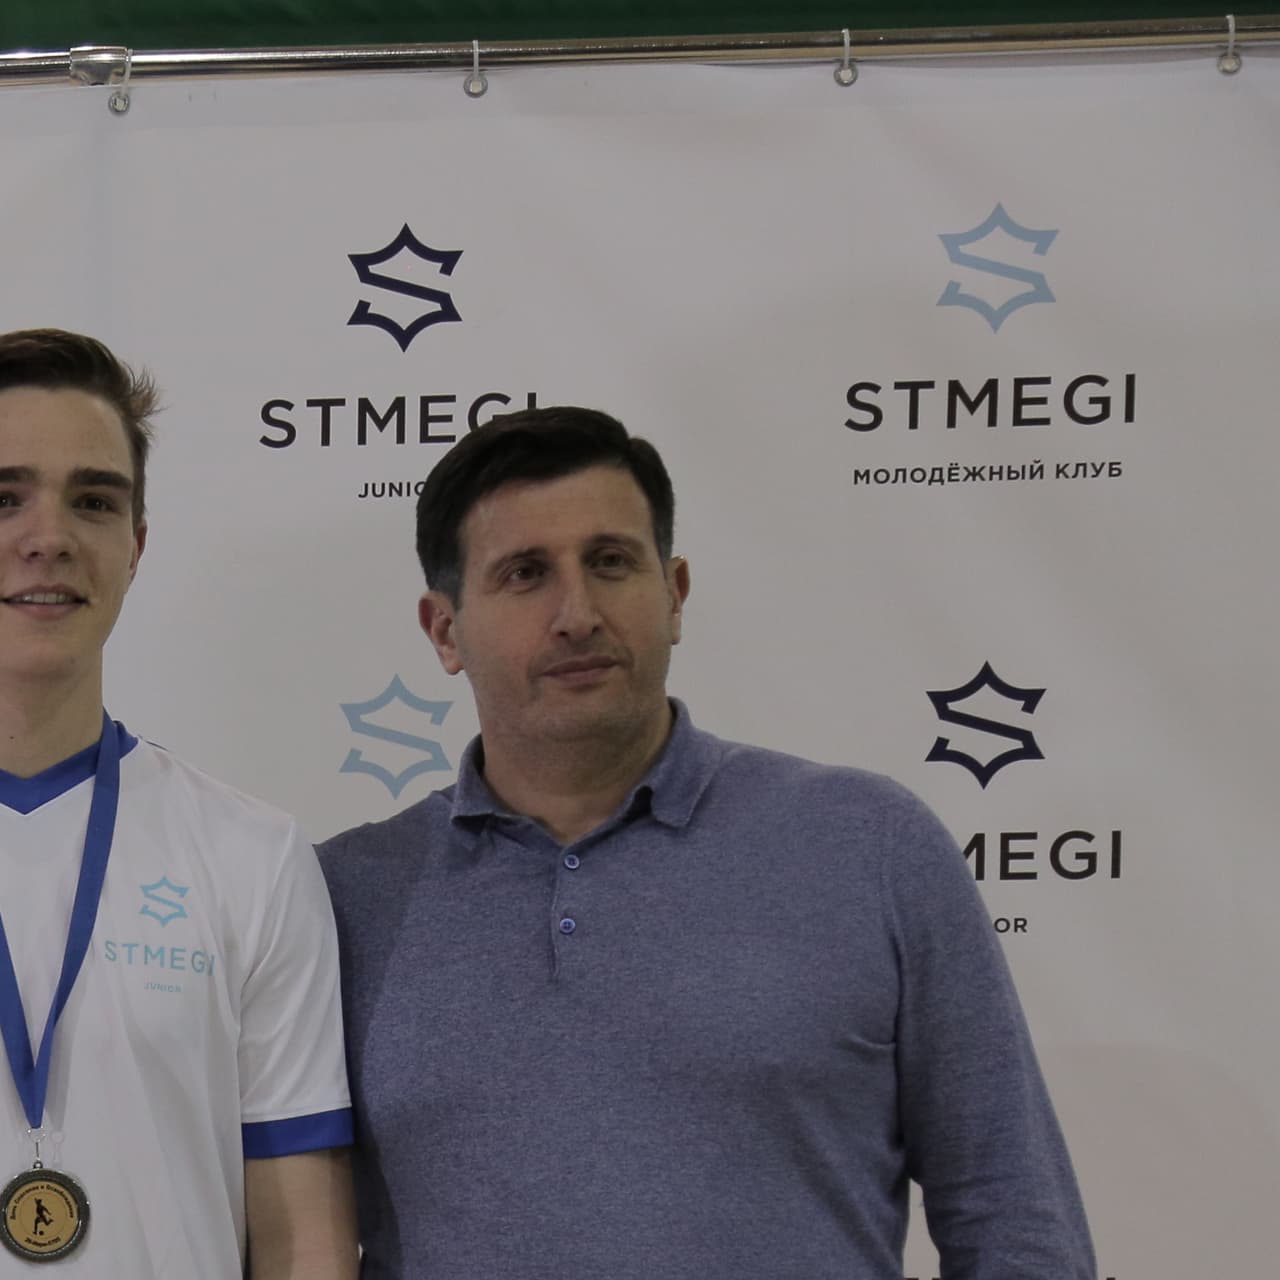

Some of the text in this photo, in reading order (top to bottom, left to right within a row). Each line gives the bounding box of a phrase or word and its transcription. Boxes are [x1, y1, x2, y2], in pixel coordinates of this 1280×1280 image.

[843, 374, 1137, 432] STMEGI
[852, 459, 1124, 487] МОЛОДЁЖНЫЙ КЛУБ
[104, 939, 216, 977] STMEGI
